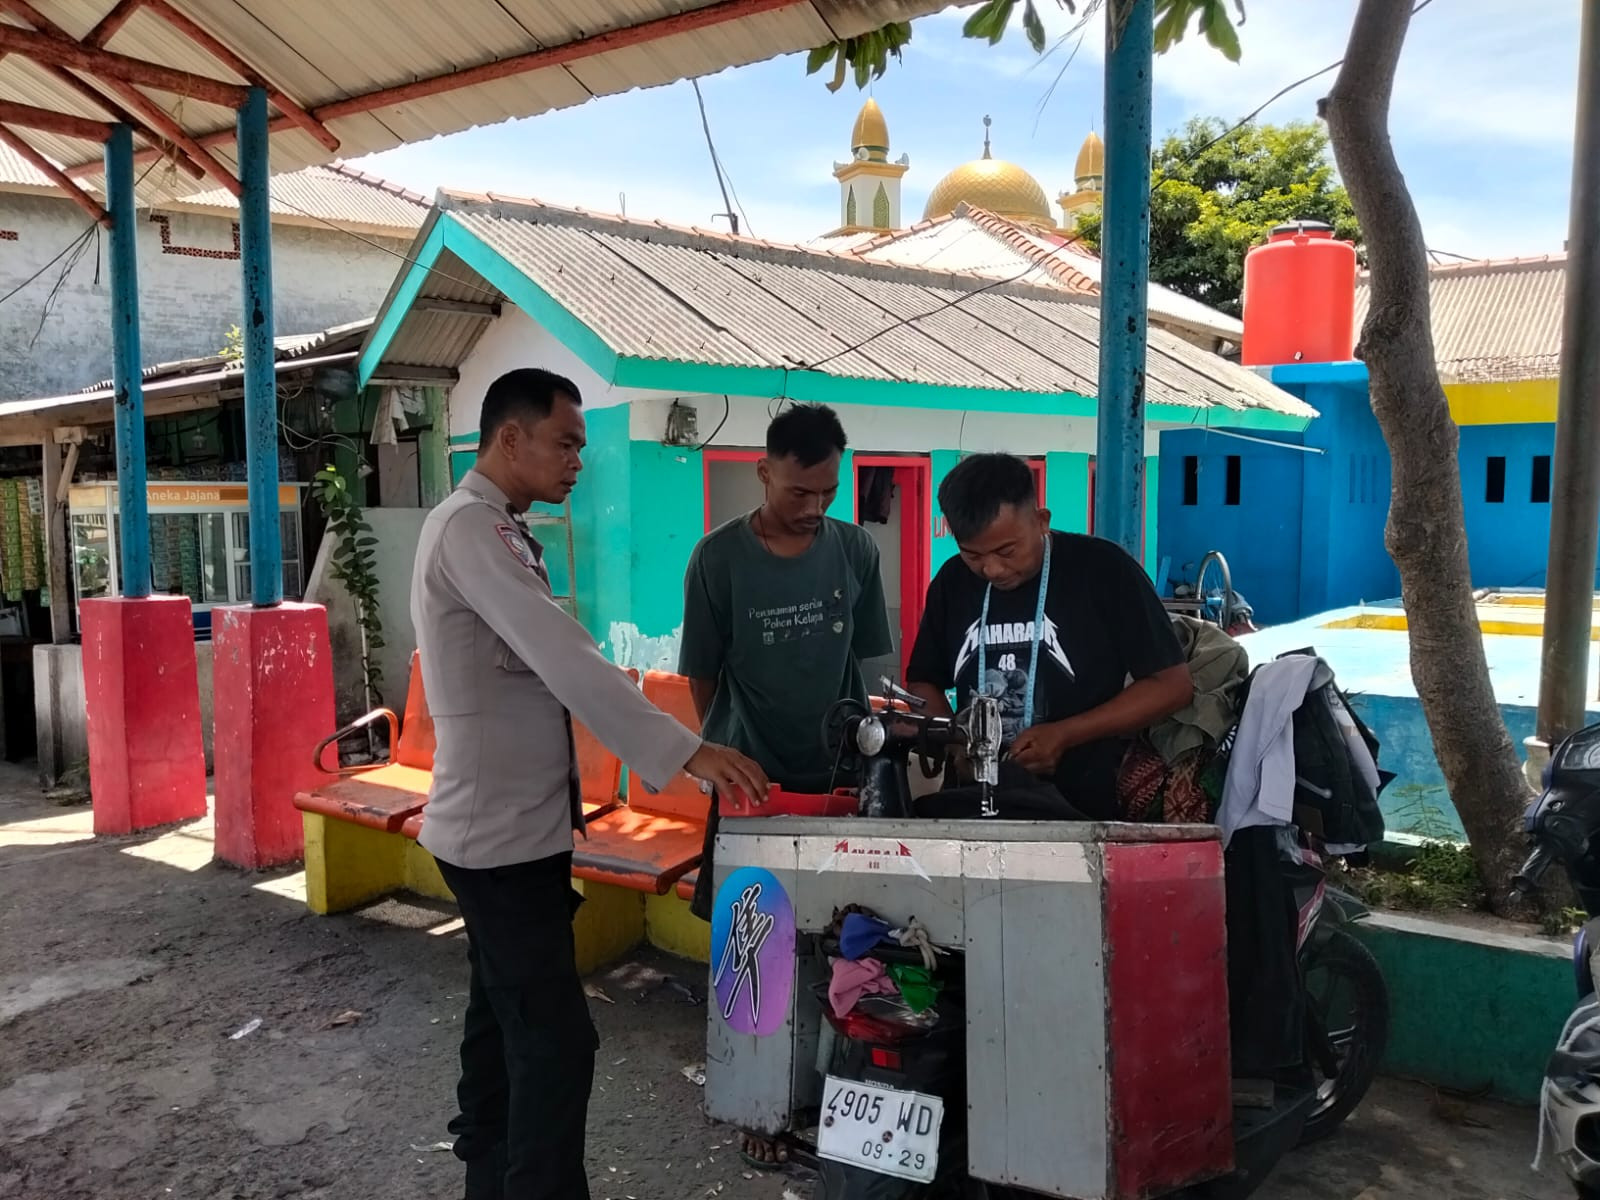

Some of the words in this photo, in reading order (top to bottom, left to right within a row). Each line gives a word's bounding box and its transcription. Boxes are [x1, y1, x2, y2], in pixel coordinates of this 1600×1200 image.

[794, 611, 824, 626] Kelapa
[998, 653, 1017, 671] 48
[827, 1088, 884, 1124] 4905
[897, 1101, 933, 1136] WD
